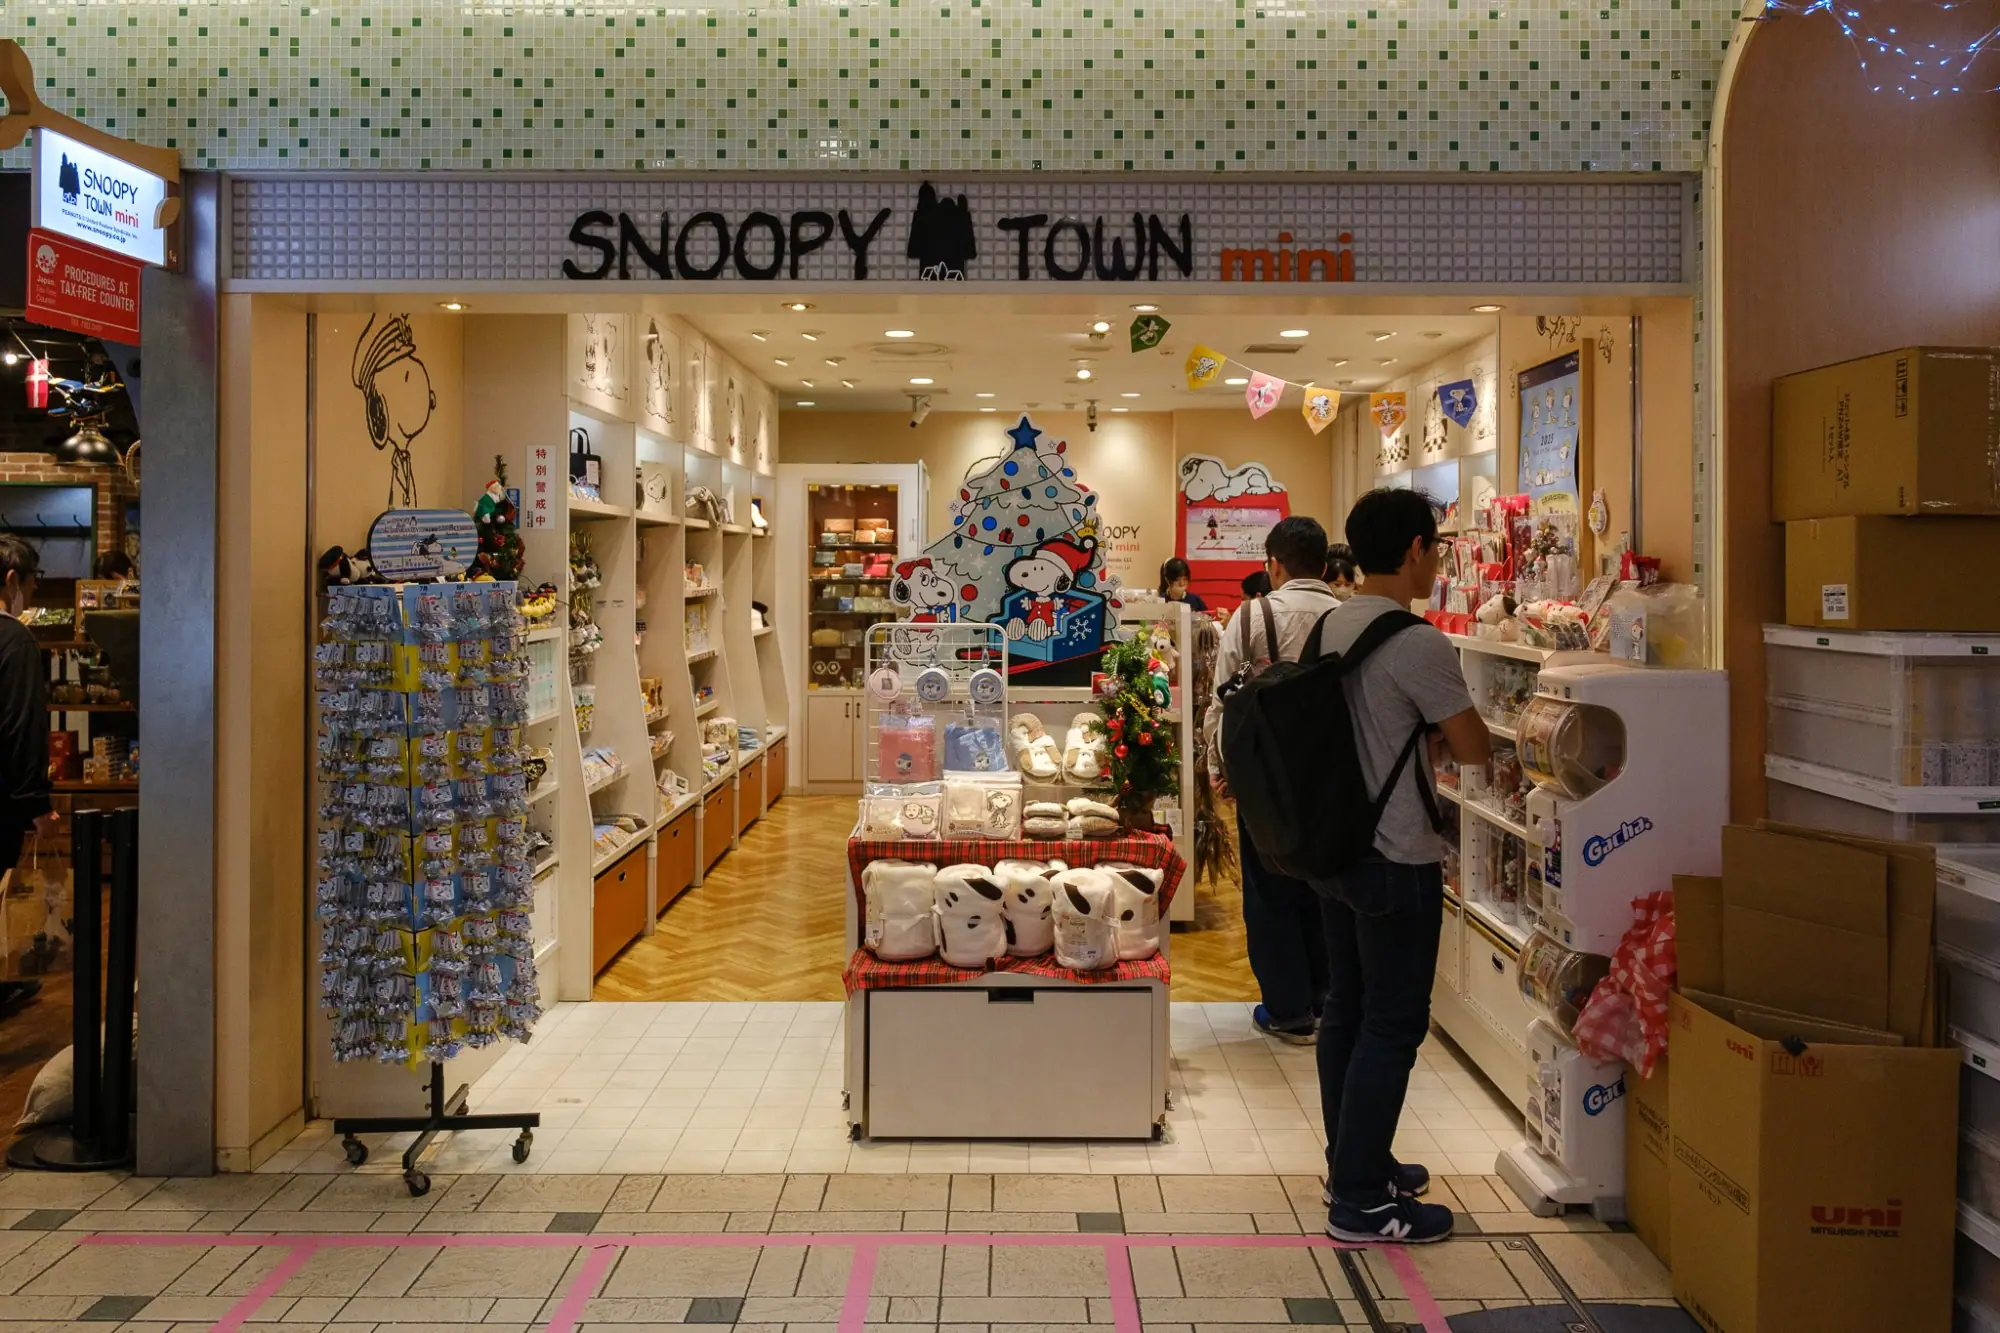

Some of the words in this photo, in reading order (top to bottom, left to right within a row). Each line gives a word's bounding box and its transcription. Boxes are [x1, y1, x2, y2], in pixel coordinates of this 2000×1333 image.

[83, 168, 139, 205] SNOOPY
[83, 193, 112, 217] TOWN
[115, 209, 139, 228] mini
[76, 221, 126, 244] www.snoopy.co.jp
[563, 210, 892, 281] SNOOPY
[997, 211, 1194, 281] TOWN
[1220, 231, 1354, 282] mini
[64, 264, 116, 292] PROCEDURES
[118, 280, 129, 296] AT
[60, 280, 97, 303] TAX-FREE
[99, 291, 135, 313] COUNTER
[535, 448, 547, 526] 特別警戒中
[1102, 526, 1141, 539] OOPY
[1726, 1038, 1754, 1062] uni
[1811, 1198, 1903, 1227] uni
[1810, 1226, 1865, 1237] MITSUBISHI
